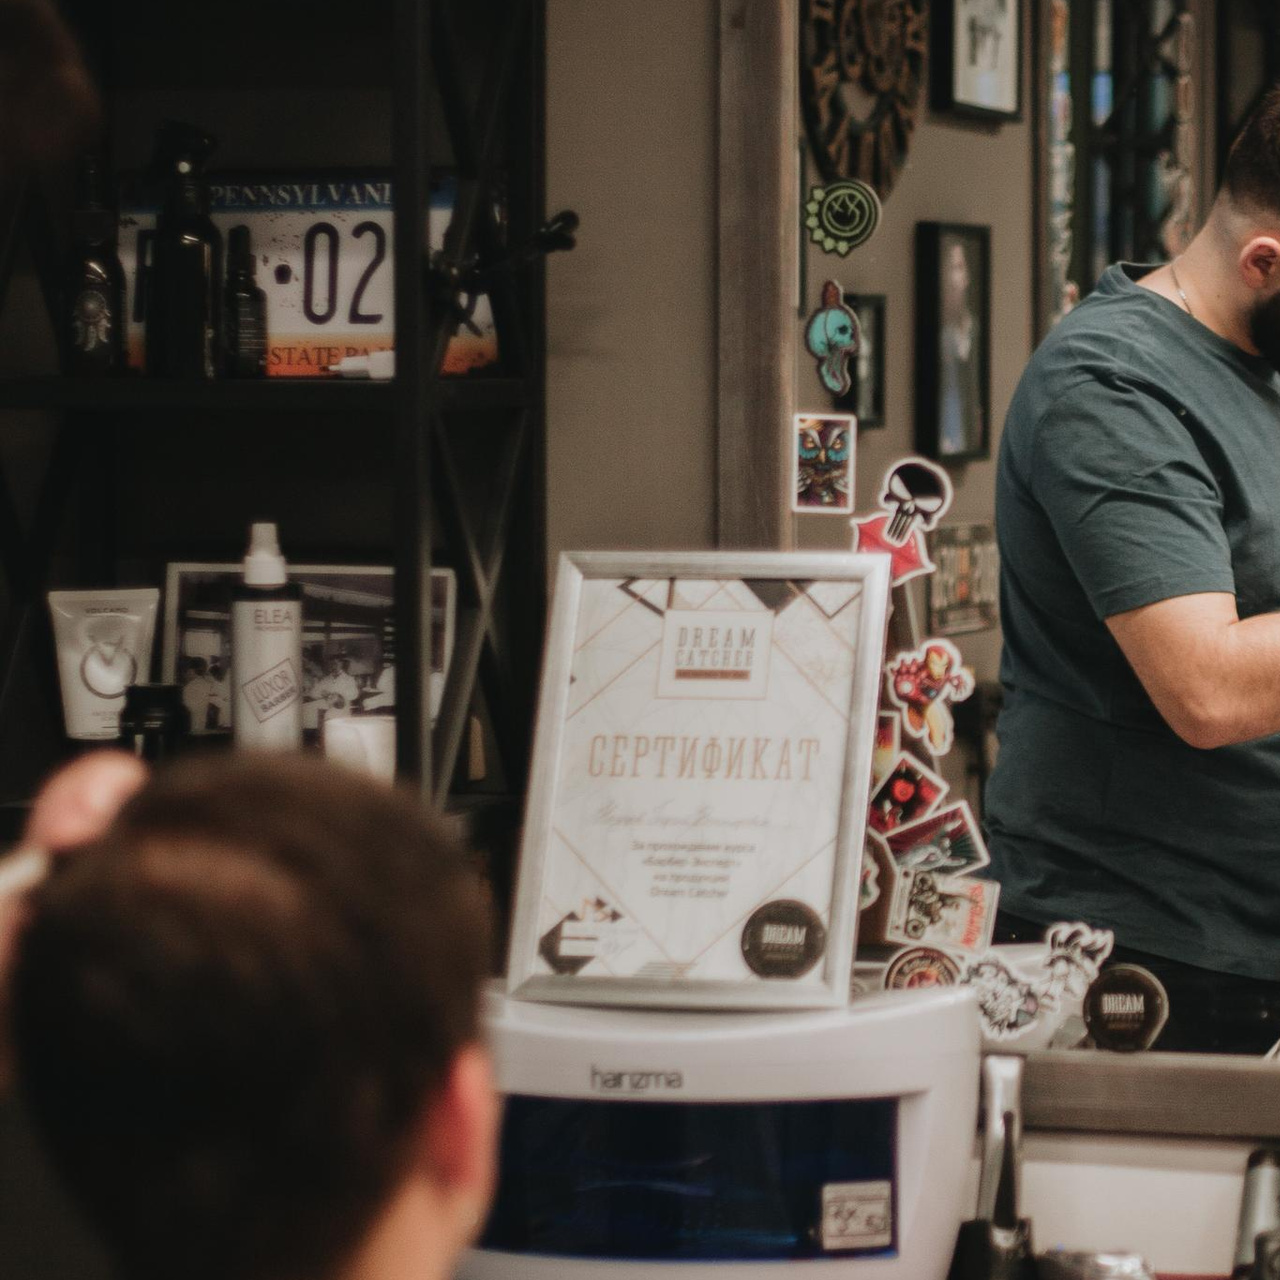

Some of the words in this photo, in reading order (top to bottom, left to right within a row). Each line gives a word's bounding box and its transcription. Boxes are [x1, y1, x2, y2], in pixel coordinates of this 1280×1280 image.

[211, 182, 393, 206] PENNSYLVANI
[677, 627, 756, 649] DREAM
[587, 733, 821, 781] СЕРТИФИКАТ
[590, 1063, 684, 1090] harizma
